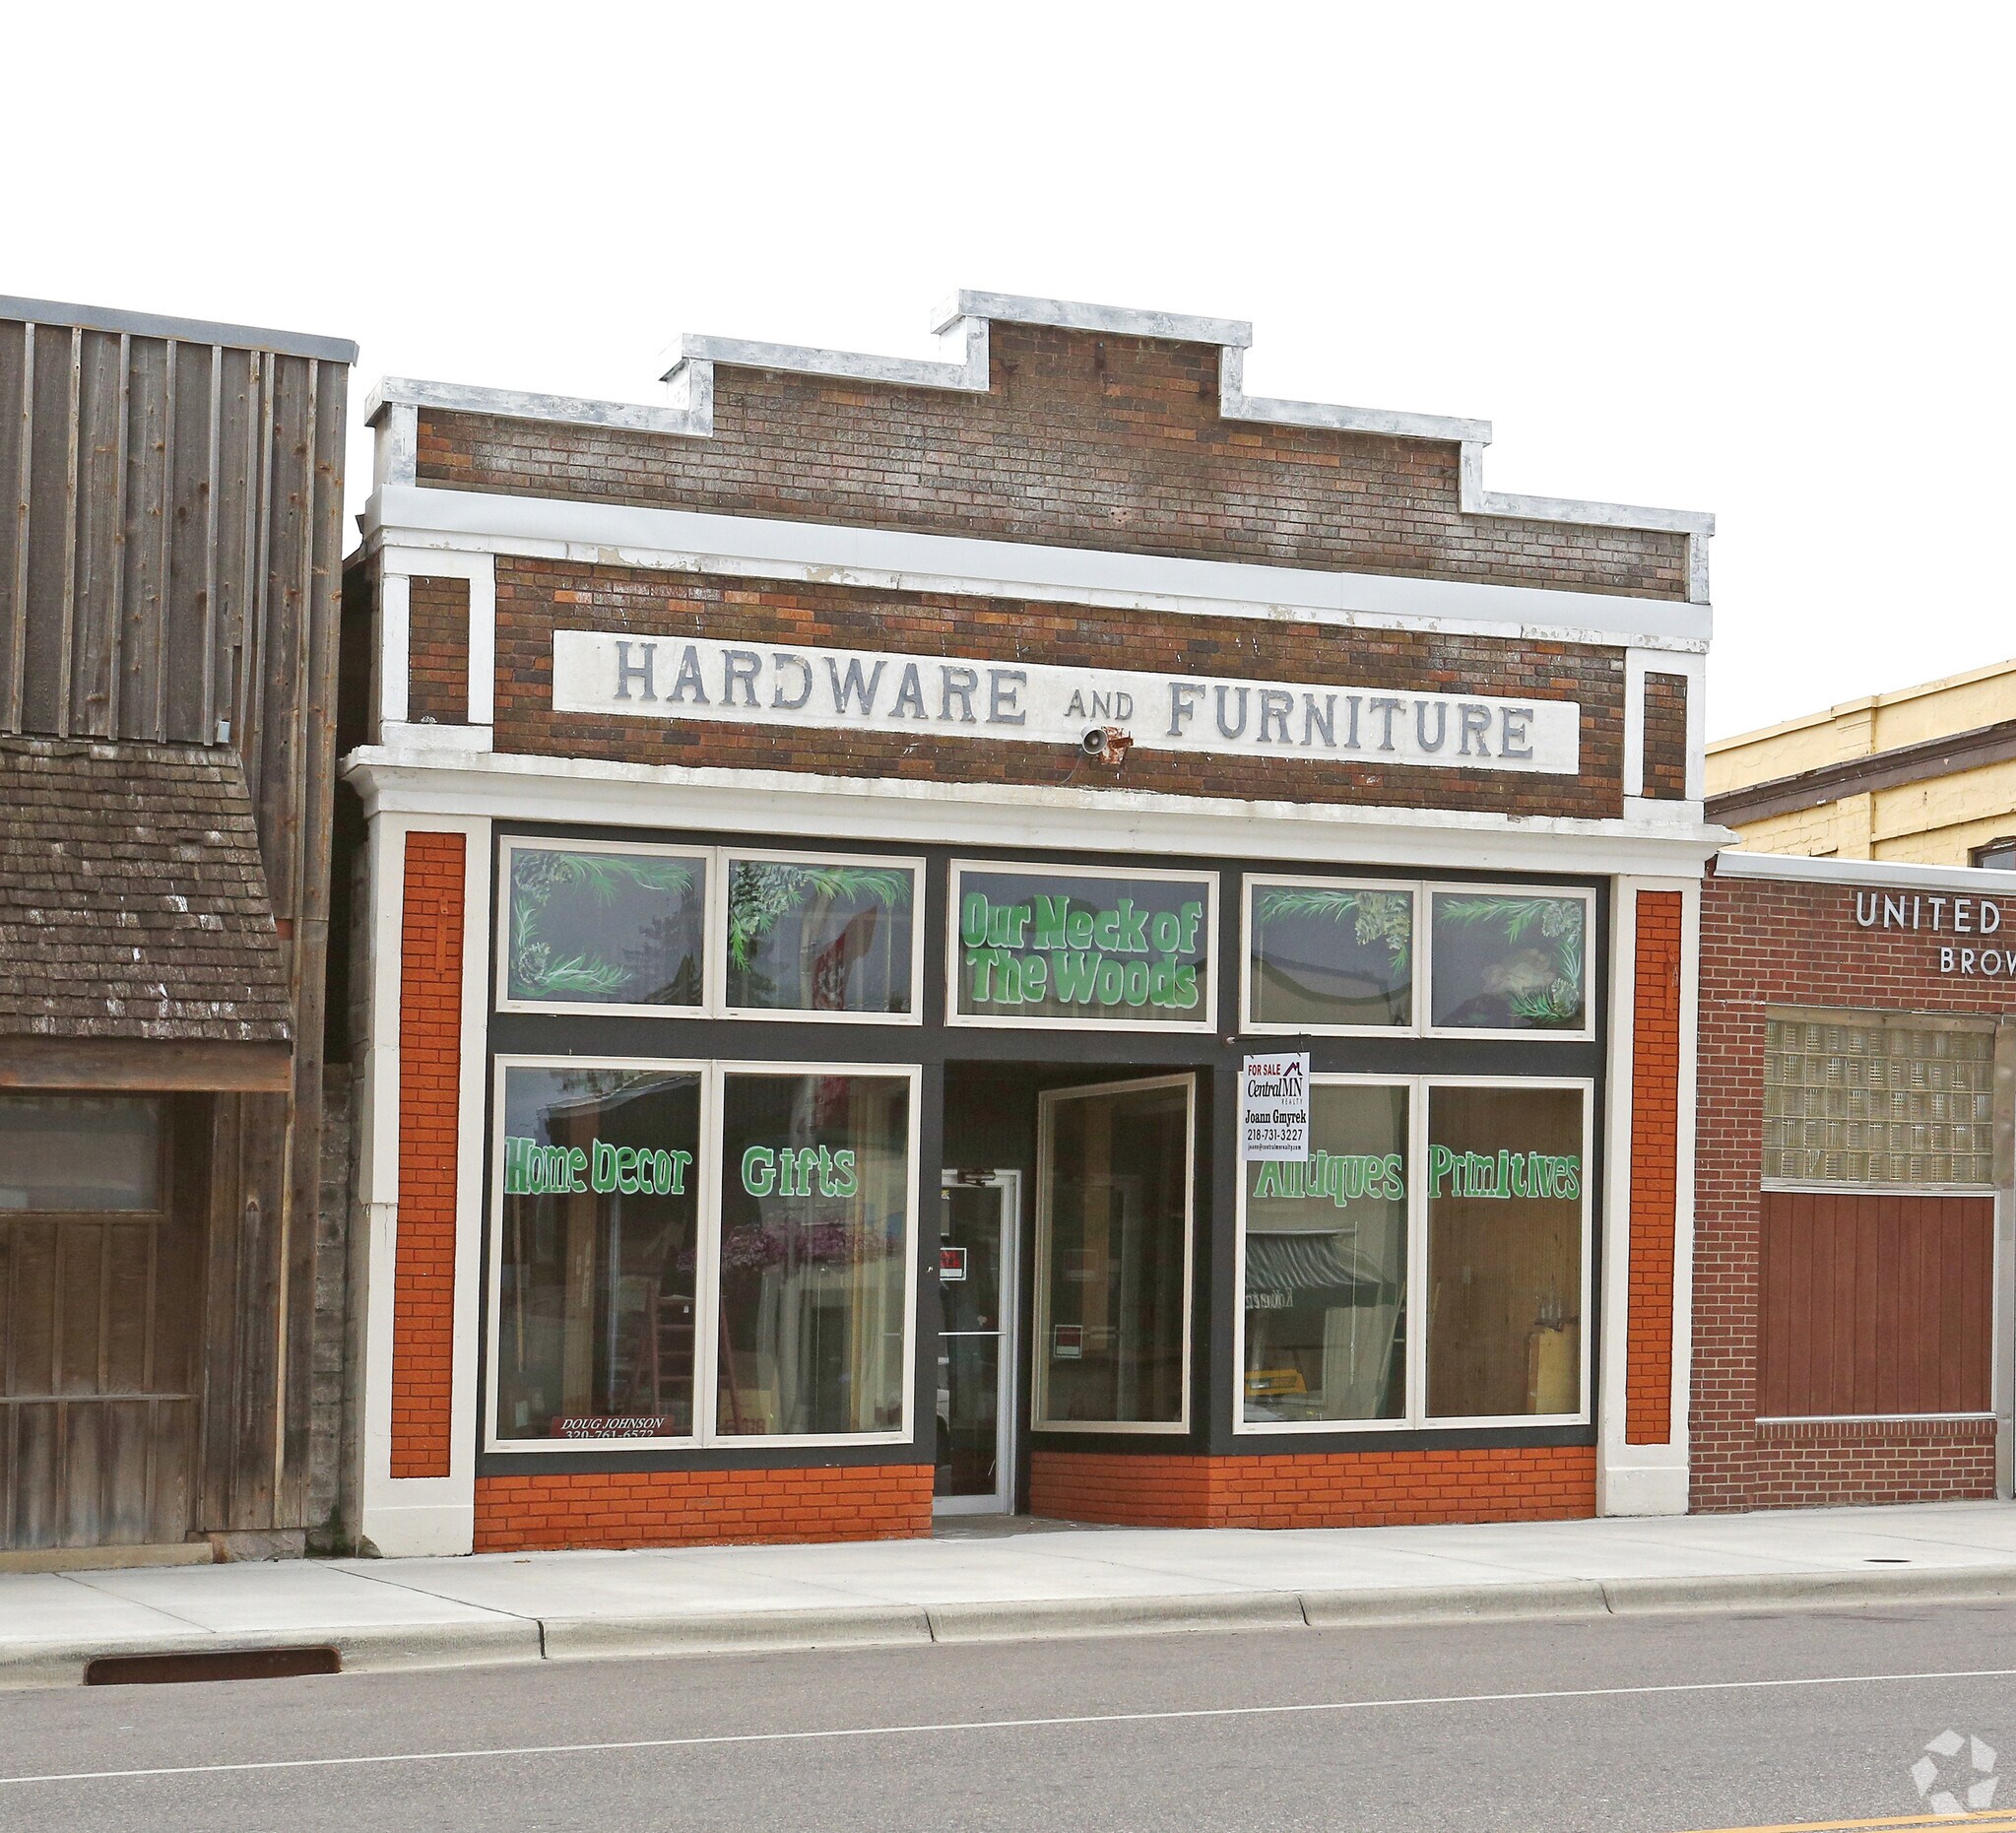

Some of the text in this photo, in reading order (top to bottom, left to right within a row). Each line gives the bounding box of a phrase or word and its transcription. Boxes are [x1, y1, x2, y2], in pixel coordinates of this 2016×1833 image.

[614, 640, 1534, 758] HARDWARE AND FURNITURE
[962, 892, 1203, 953] Our Neck of
[1856, 891, 2000, 934] UNITED
[966, 949, 1199, 1010] The Woods
[1248, 1064, 1281, 1077] FOR SALE
[1245, 1109, 1307, 1128] Joann Gmyrek
[1247, 1129, 1303, 1142] 218-731-3227
[504, 1137, 692, 1196] Home Decor
[742, 1145, 859, 1197] Gifts
[1253, 1149, 1405, 1208] Antiques
[1428, 1144, 1582, 1201] Primitives
[560, 1417, 665, 1430] DOUG JOHNSON
